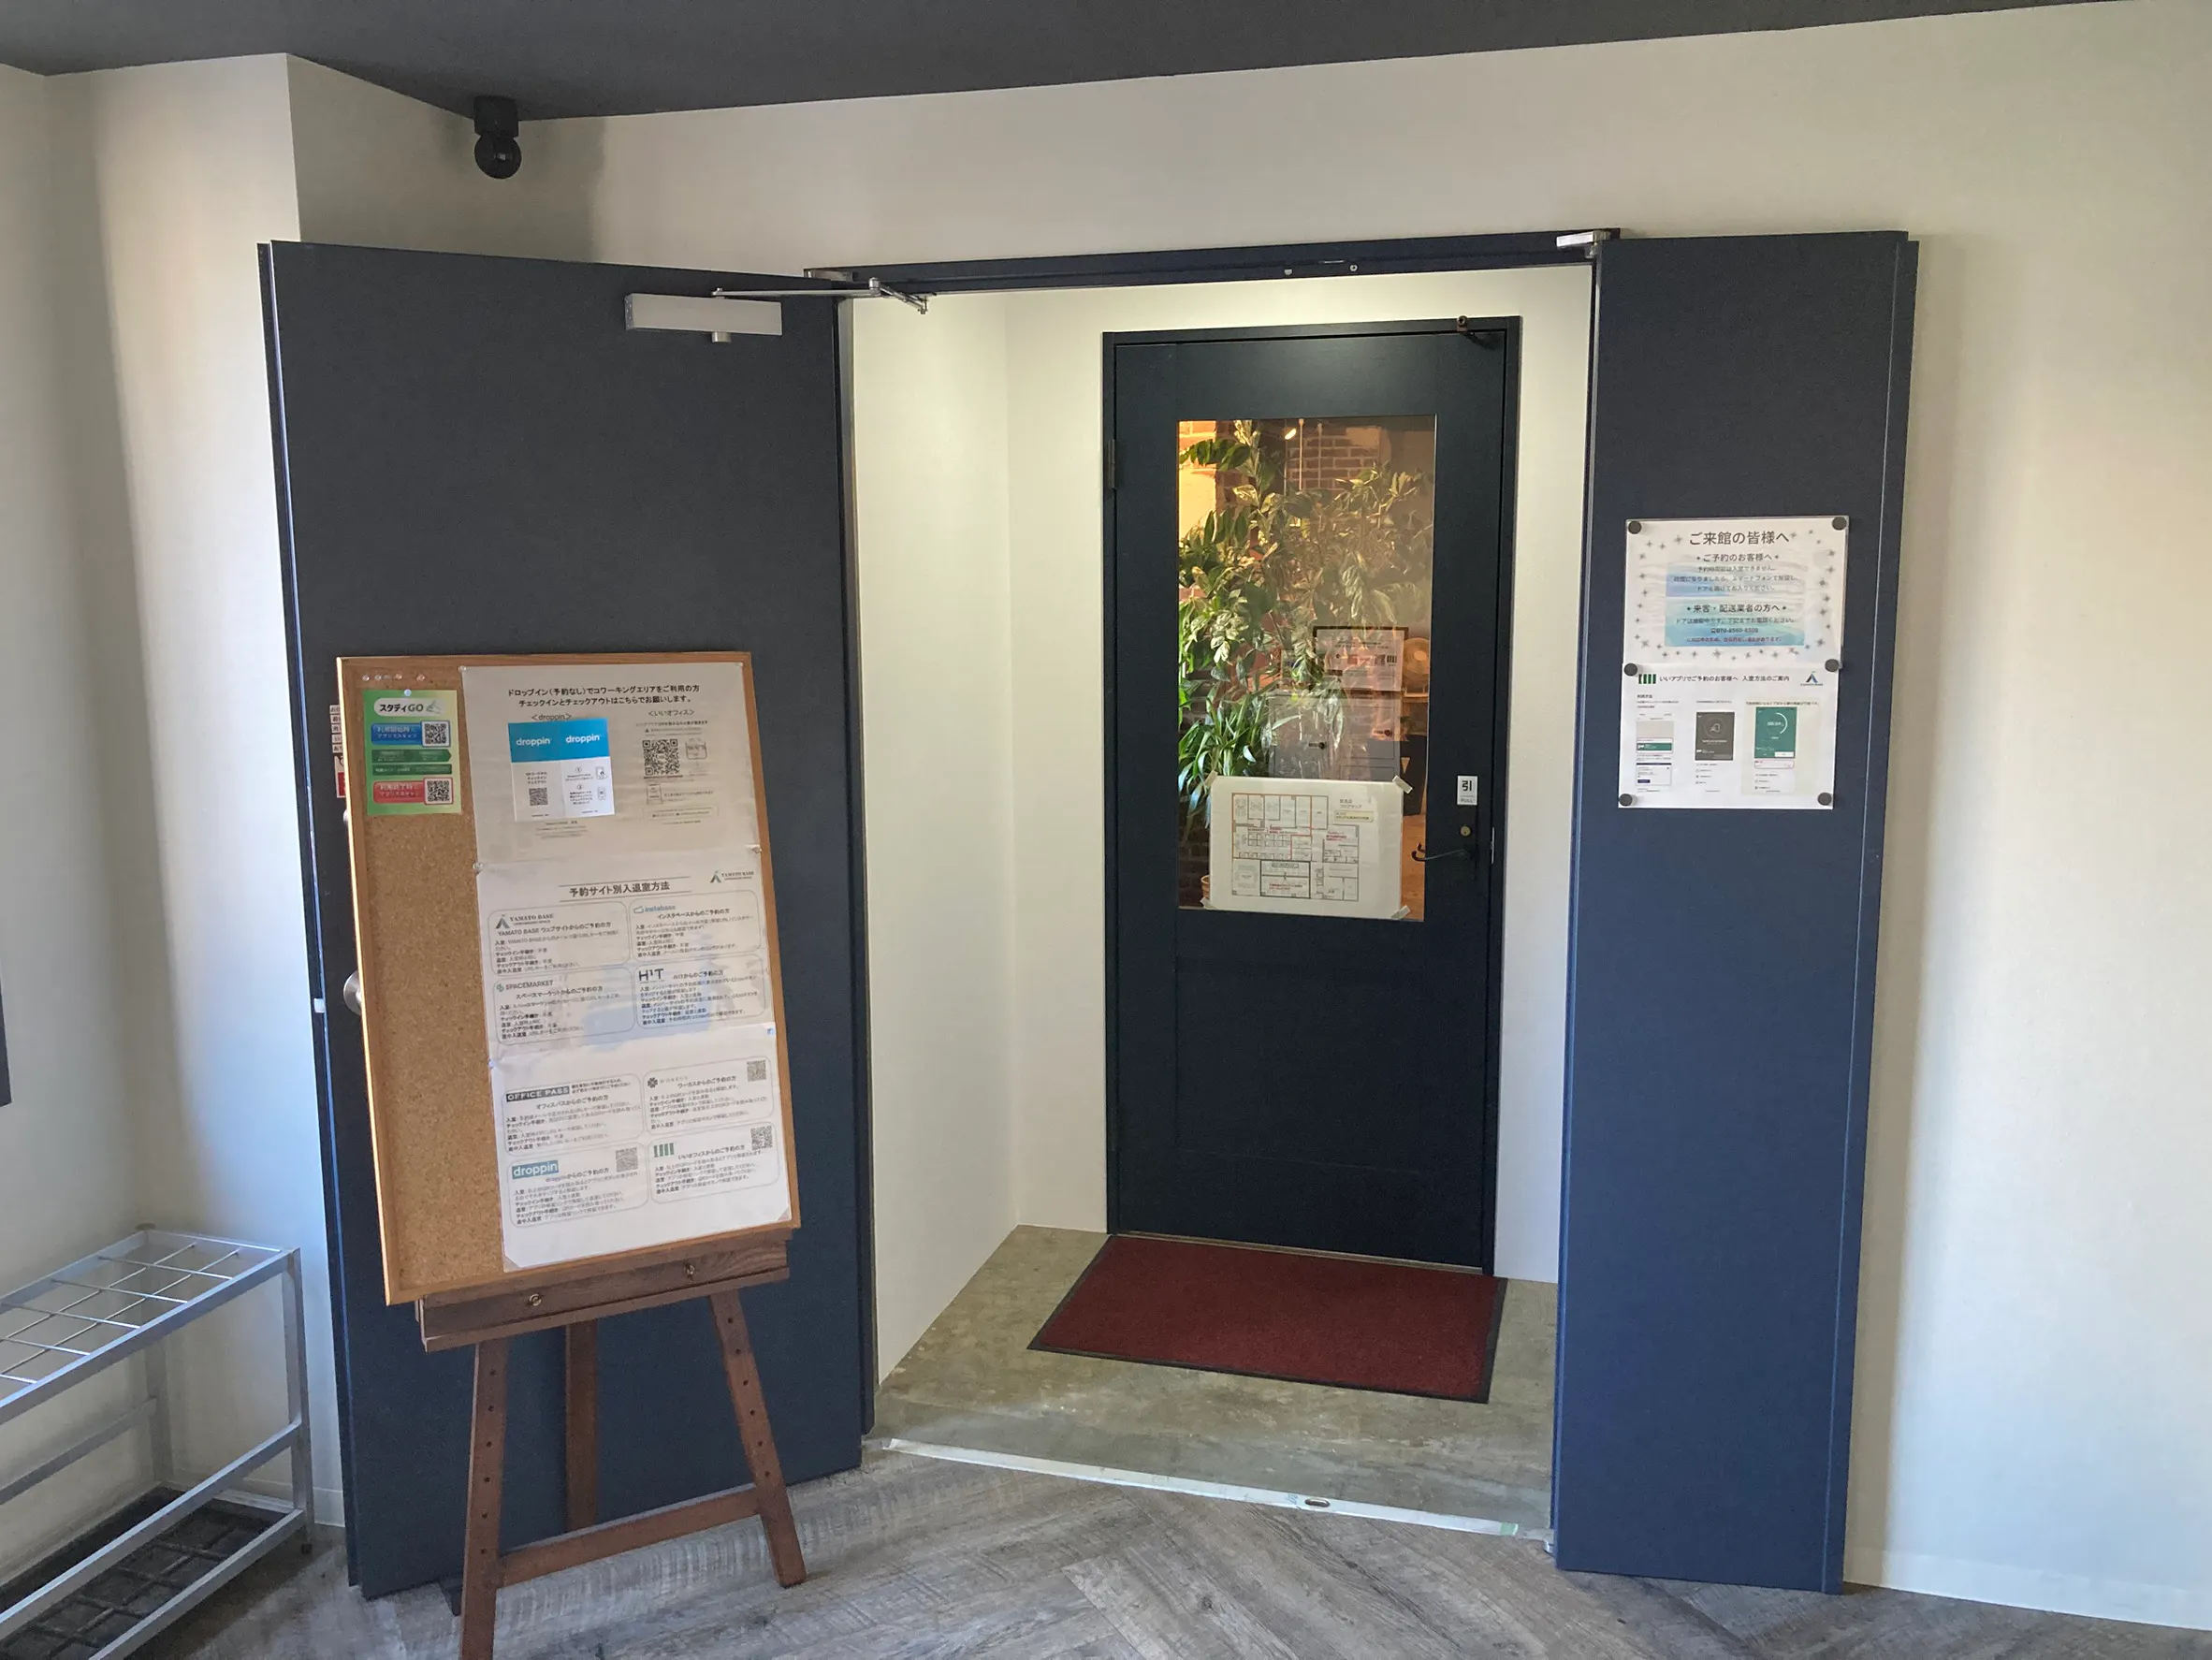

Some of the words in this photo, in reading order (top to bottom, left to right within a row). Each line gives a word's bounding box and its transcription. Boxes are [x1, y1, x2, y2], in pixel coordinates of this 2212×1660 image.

[1689, 531, 1789, 546] ご来館の皆様へ
[1703, 553, 1773, 562] ご予約のお客様へ
[1693, 604, 1781, 613] 来客・配送業者の方へ
[1659, 675, 1739, 683] いいアプリでご予約のお客様へ
[518, 695, 691, 707] チェックインとチェックアウトはこちらでお願いします。
[379, 704, 424, 712] スタディGO
[517, 736, 551, 747] droppin
[565, 734, 601, 744] droppin
[1462, 779, 1473, 792] 引
[569, 881, 671, 897] 予約サイト別入退室方法
[505, 980, 554, 990] SPACEMARKET
[507, 1091, 542, 1101] OFFICE
[546, 1087, 569, 1096] PASS
[514, 1162, 558, 1177] droppin
